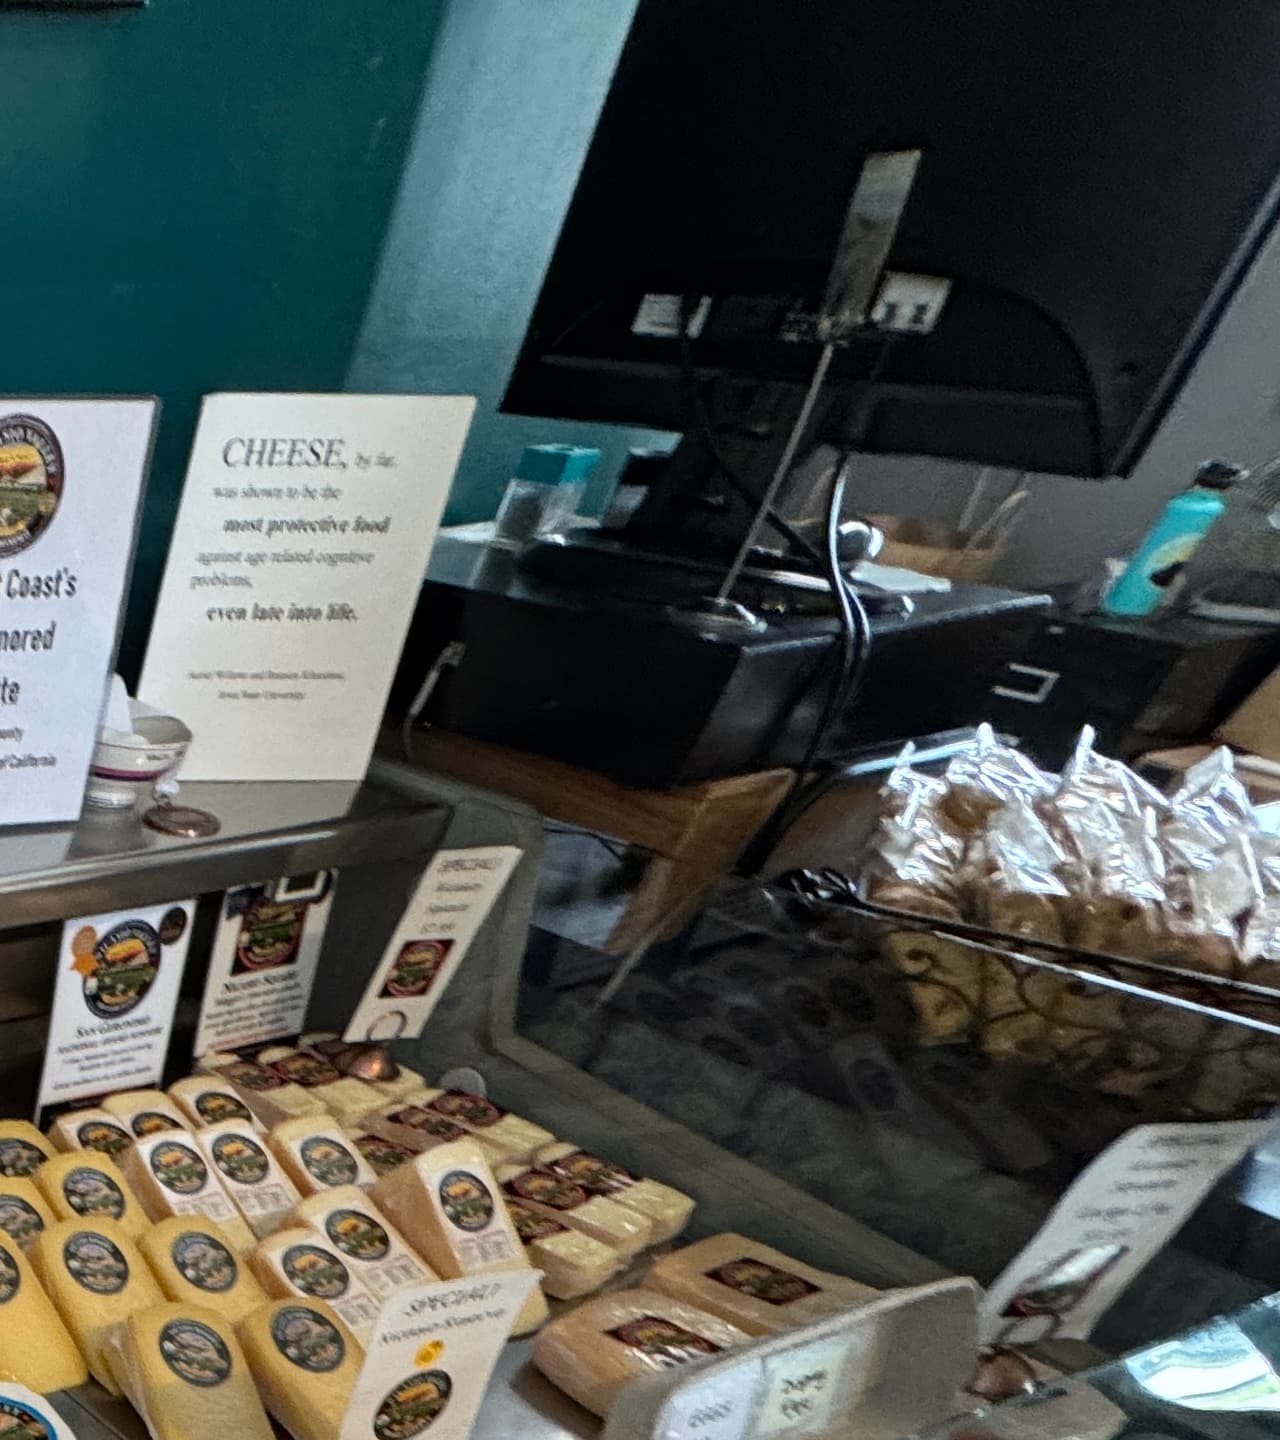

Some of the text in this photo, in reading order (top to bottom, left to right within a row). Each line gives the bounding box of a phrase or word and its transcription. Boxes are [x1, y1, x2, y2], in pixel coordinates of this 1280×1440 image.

[222, 437, 347, 469] CHEESE,
[223, 515, 390, 537] most protective food
[6, 567, 77, 597] Coast's
[207, 602, 359, 621] even late into life.
